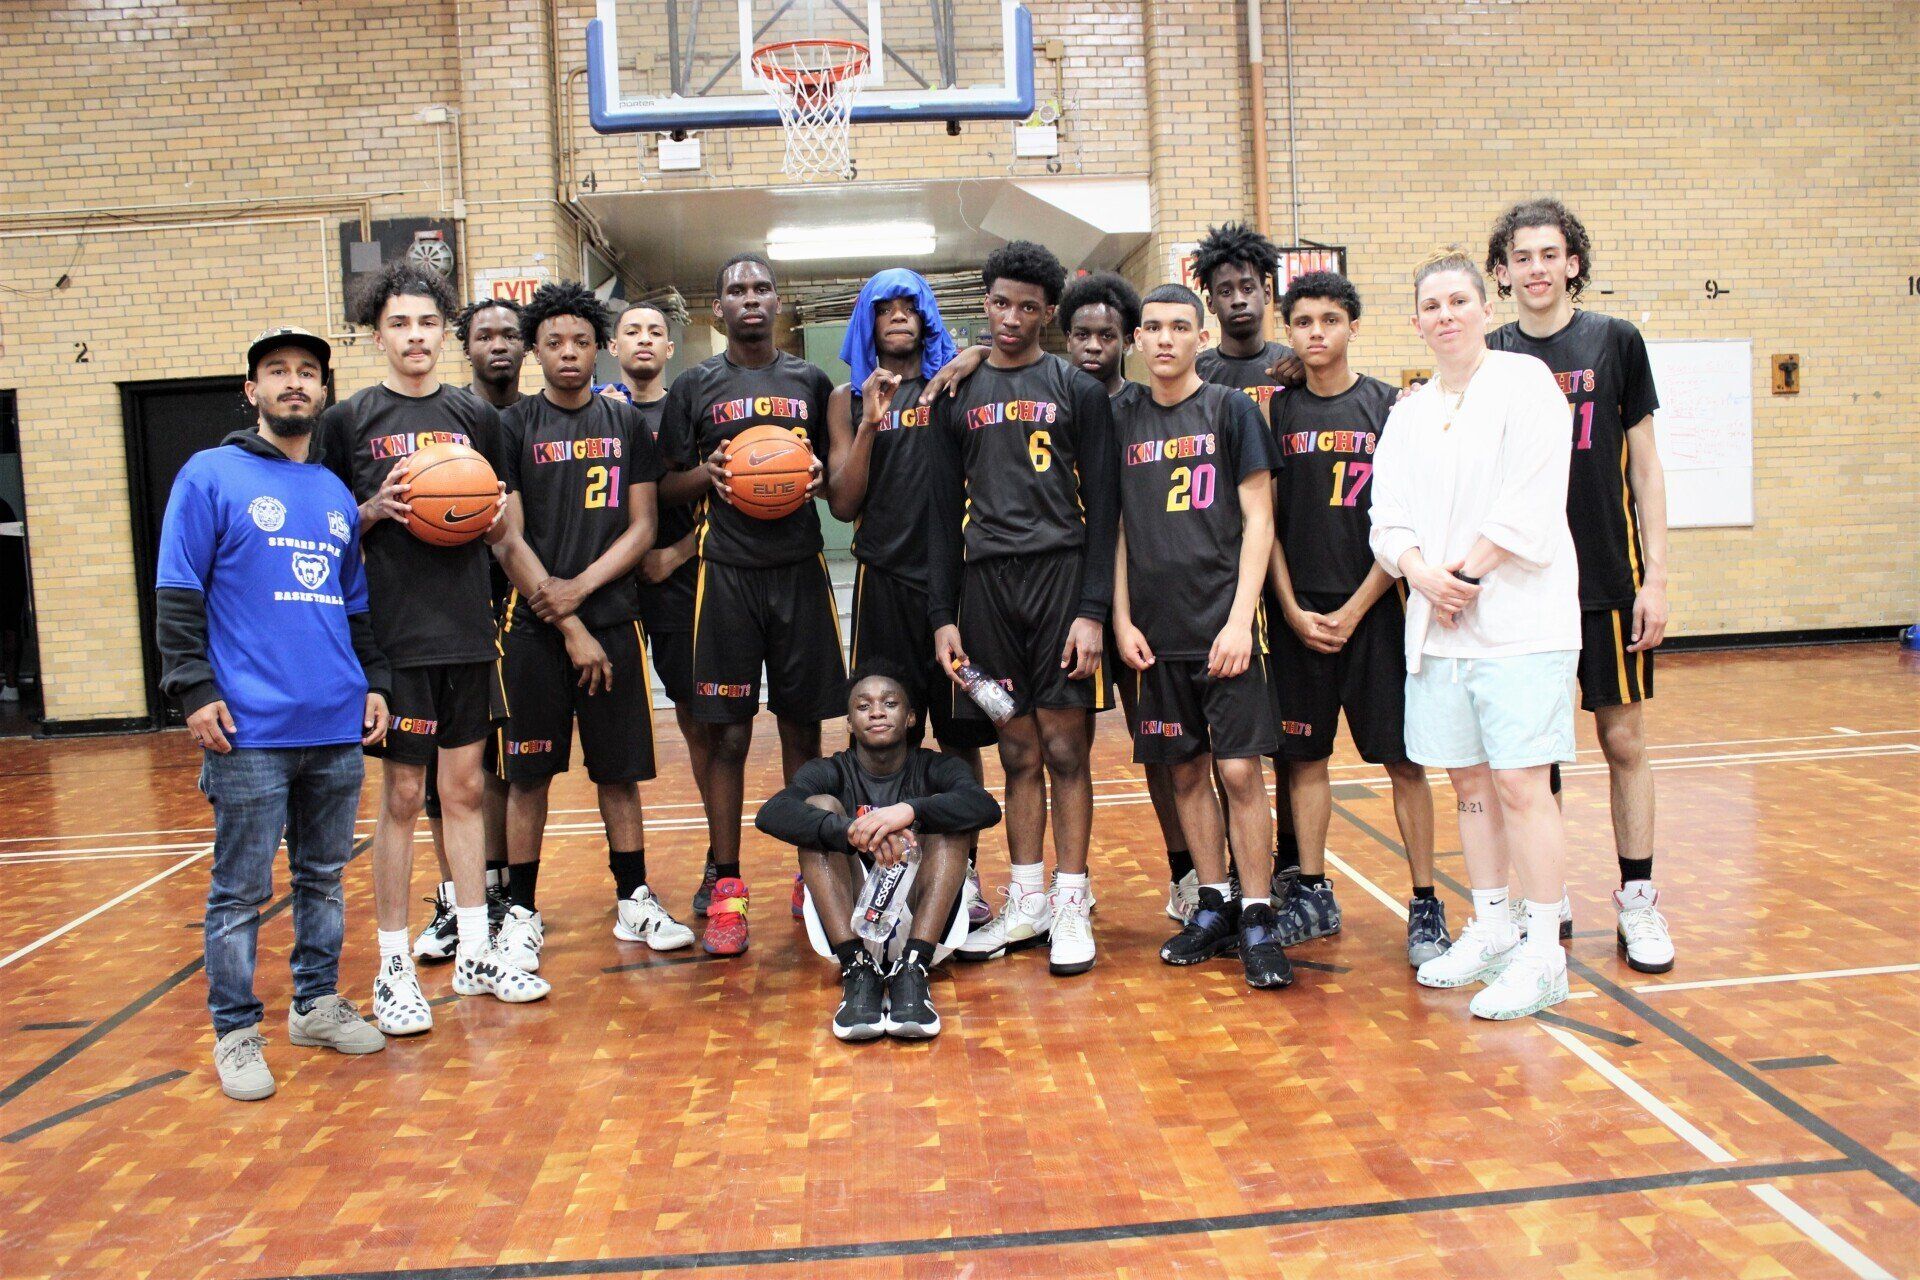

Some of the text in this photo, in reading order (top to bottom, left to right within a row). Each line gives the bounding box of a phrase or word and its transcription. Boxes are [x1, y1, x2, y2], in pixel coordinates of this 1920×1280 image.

[582, 172, 597, 192] 4
[75, 342, 88, 362] 2
[713, 396, 808, 424] KNIGHTS
[967, 400, 1057, 429] KNIGHTS
[533, 438, 622, 464] KNIGHTS
[1029, 430, 1052, 472] 6
[1127, 433, 1216, 466] KNIGHTS
[1283, 430, 1376, 455] KNIGHTS
[585, 465, 620, 508] 21
[753, 481, 795, 495] ELITE
[1166, 463, 1216, 512] 20
[1329, 461, 1373, 507] 17
[697, 682, 751, 698] KNIGHTS
